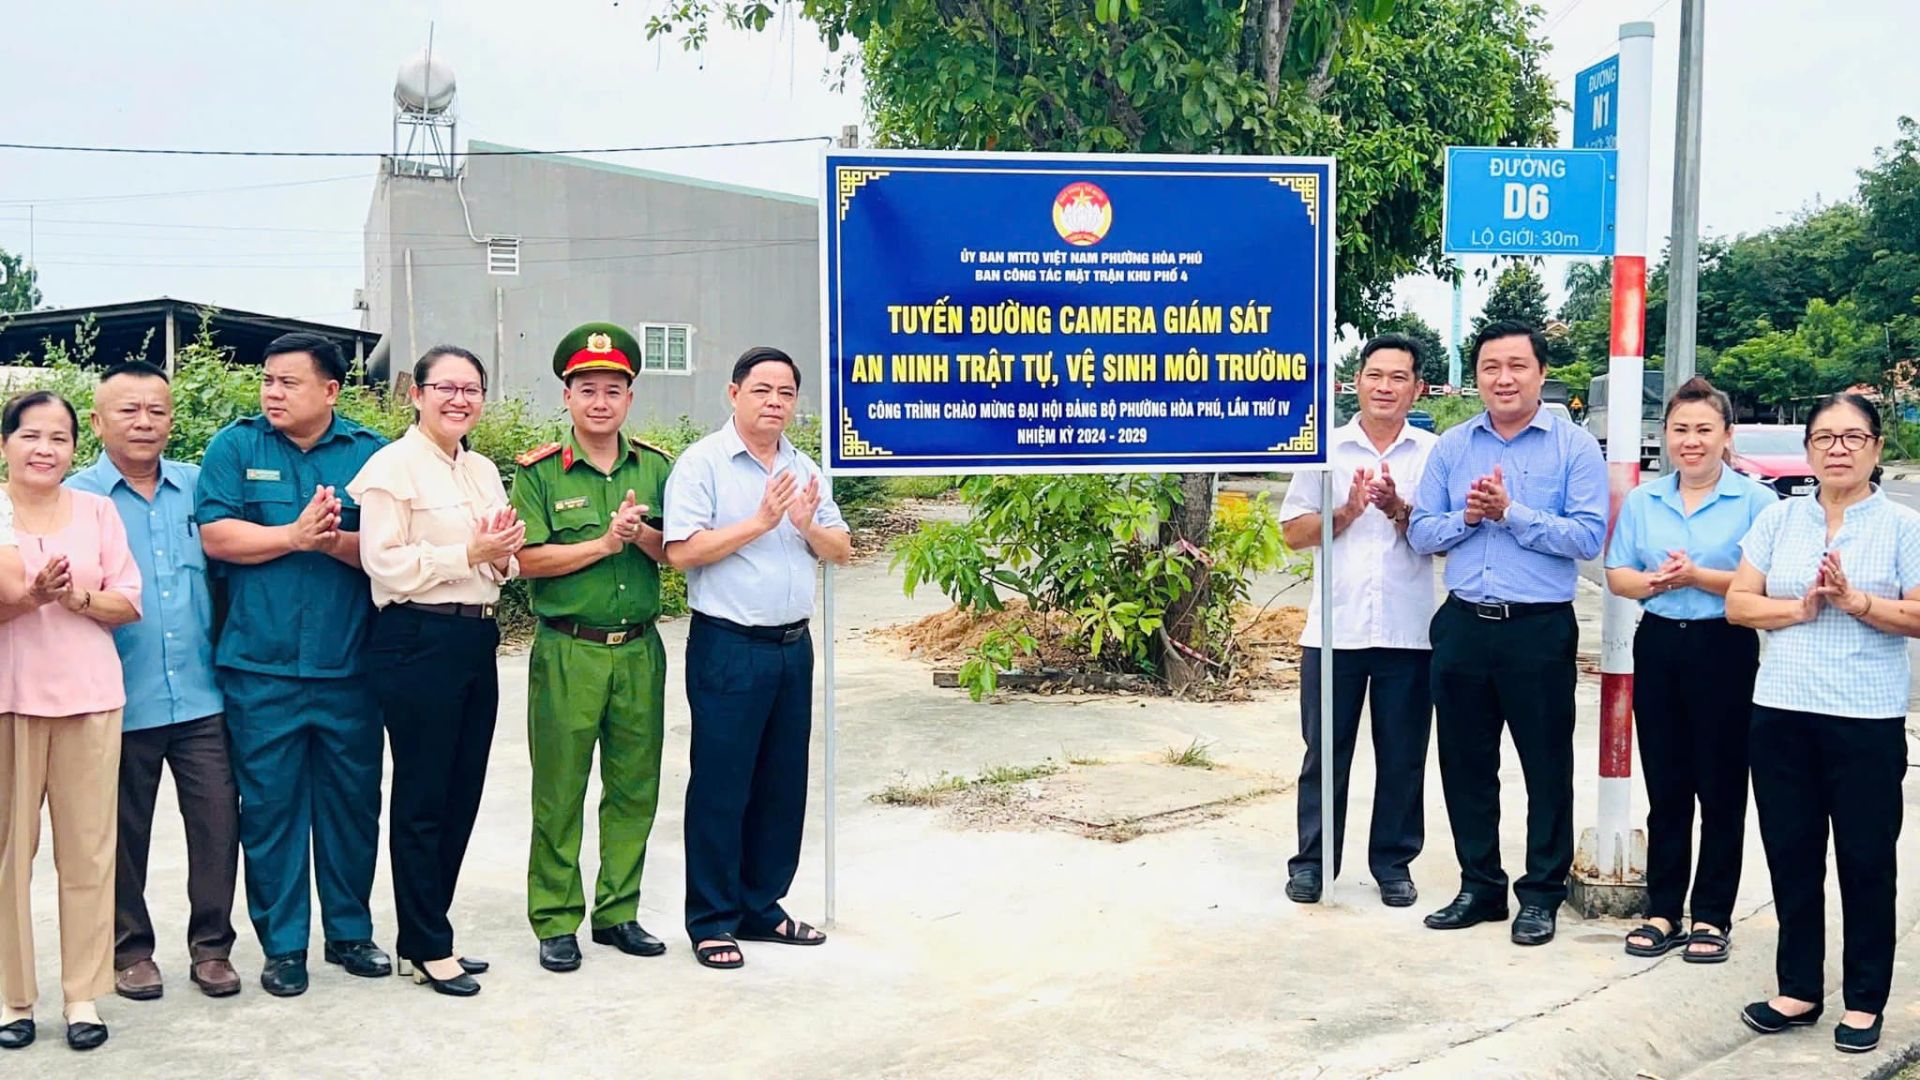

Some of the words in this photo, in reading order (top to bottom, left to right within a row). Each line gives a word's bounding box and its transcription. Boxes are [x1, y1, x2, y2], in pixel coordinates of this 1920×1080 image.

[1592, 91, 1610, 131] N1
[1489, 154, 1567, 178] ĐƯỜNG
[1503, 182, 1550, 221] D6
[1471, 228, 1494, 249] LỘ
[1498, 227, 1538, 246] GIỚI:
[1541, 230, 1580, 247] 30m
[960, 248, 976, 263] ỦY
[979, 251, 1004, 263] BAN
[1007, 251, 1040, 264] MTTQ
[1043, 250, 1067, 265] VIỆT
[1070, 252, 1099, 263] NAM
[1101, 250, 1149, 264] PHƯỜNG
[1152, 250, 1176, 264] HÒA
[975, 269, 1000, 281] BAN
[1003, 268, 1036, 282] CÔNG
[1039, 267, 1062, 281] TÁC
[1065, 269, 1090, 284] MẶT
[1093, 268, 1125, 284] TRẬN
[1127, 270, 1151, 281] KHU
[1154, 267, 1178, 282] PHỐ
[1180, 271, 1188, 282] 4
[888, 295, 963, 334] TUYẾN
[970, 299, 1051, 334] ĐƯỜNG
[1059, 306, 1157, 334] CAMERA
[1163, 299, 1222, 334] GIÁM
[1229, 299, 1272, 334] SÁT
[851, 354, 883, 383] AN
[891, 354, 949, 383] NINH
[956, 347, 1015, 389] TRẬT
[1021, 351, 1059, 387] TỰ,
[1066, 347, 1096, 389] VỆ
[1102, 354, 1157, 382] SINH
[1164, 347, 1209, 382] MÔI
[1215, 347, 1307, 382] TRƯỜNG
[868, 400, 901, 419] CÔNG
[904, 400, 940, 419] TRÌNH
[944, 399, 976, 419] CHÀO
[980, 399, 1015, 418] MỪNG
[1018, 403, 1039, 421] ĐẠI
[1041, 398, 1063, 421] HỘI
[1065, 398, 1097, 418] ĐẢNG
[1100, 398, 1117, 421] BỘ
[1119, 398, 1168, 418] PHƯỜNG
[1170, 398, 1194, 417] HÒA
[1197, 398, 1225, 419] PHÚ,
[1252, 396, 1276, 416] THỨ
[1278, 401, 1291, 416] IV
[1017, 425, 1056, 447] NHIỆM
[1077, 428, 1107, 444] 2024
[1118, 428, 1148, 443] 2029
